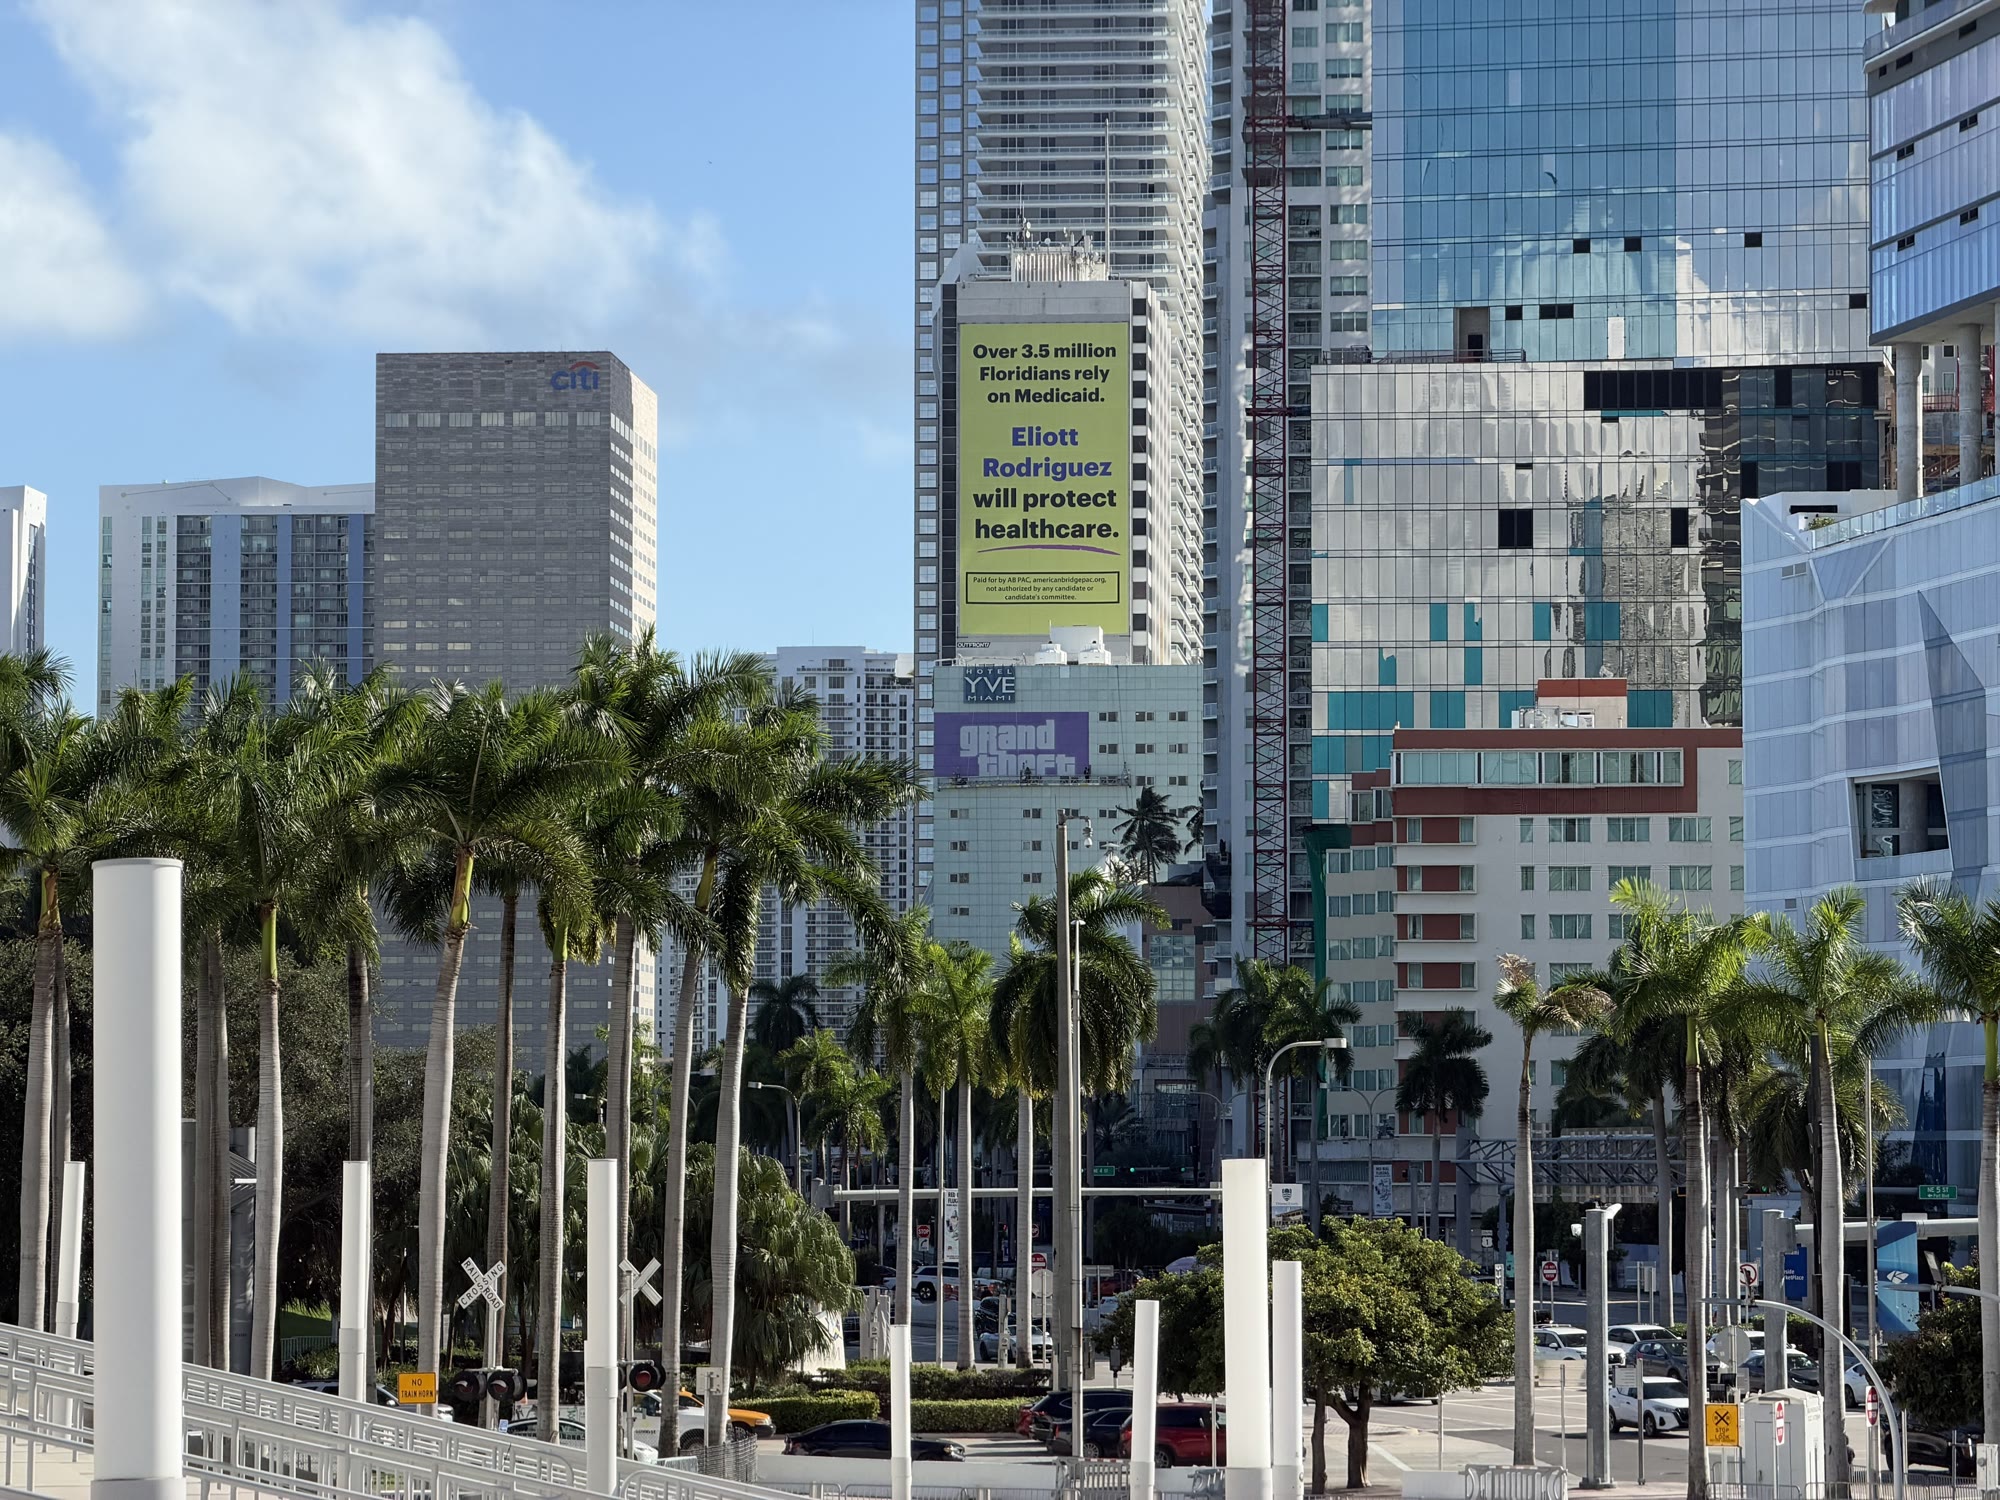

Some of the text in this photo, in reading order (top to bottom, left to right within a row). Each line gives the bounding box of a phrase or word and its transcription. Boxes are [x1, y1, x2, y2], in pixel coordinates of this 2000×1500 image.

[973, 343, 1117, 359] Over 3.5 million
[551, 366, 599, 390] citi
[979, 365, 1110, 383] Floridians rely
[987, 387, 1105, 403] on Medicaid.
[1011, 426, 1079, 447] Eliott
[982, 457, 1112, 481] Rodriguez
[972, 488, 1117, 512] will protect
[975, 519, 1119, 539] healthcare.
[998, 577, 1006, 585] by
[1032, 576, 1107, 585] americanbridgepac.org,
[1033, 585, 1041, 593] by
[964, 676, 1016, 693] YVE
[1936, 1186, 1941, 1194] 5
[460, 1264, 504, 1306] CROSSING
[464, 1260, 501, 1309] RAIL ROAD
[411, 1379, 423, 1387] NO
[401, 1390, 434, 1398] TRAIN HORN
